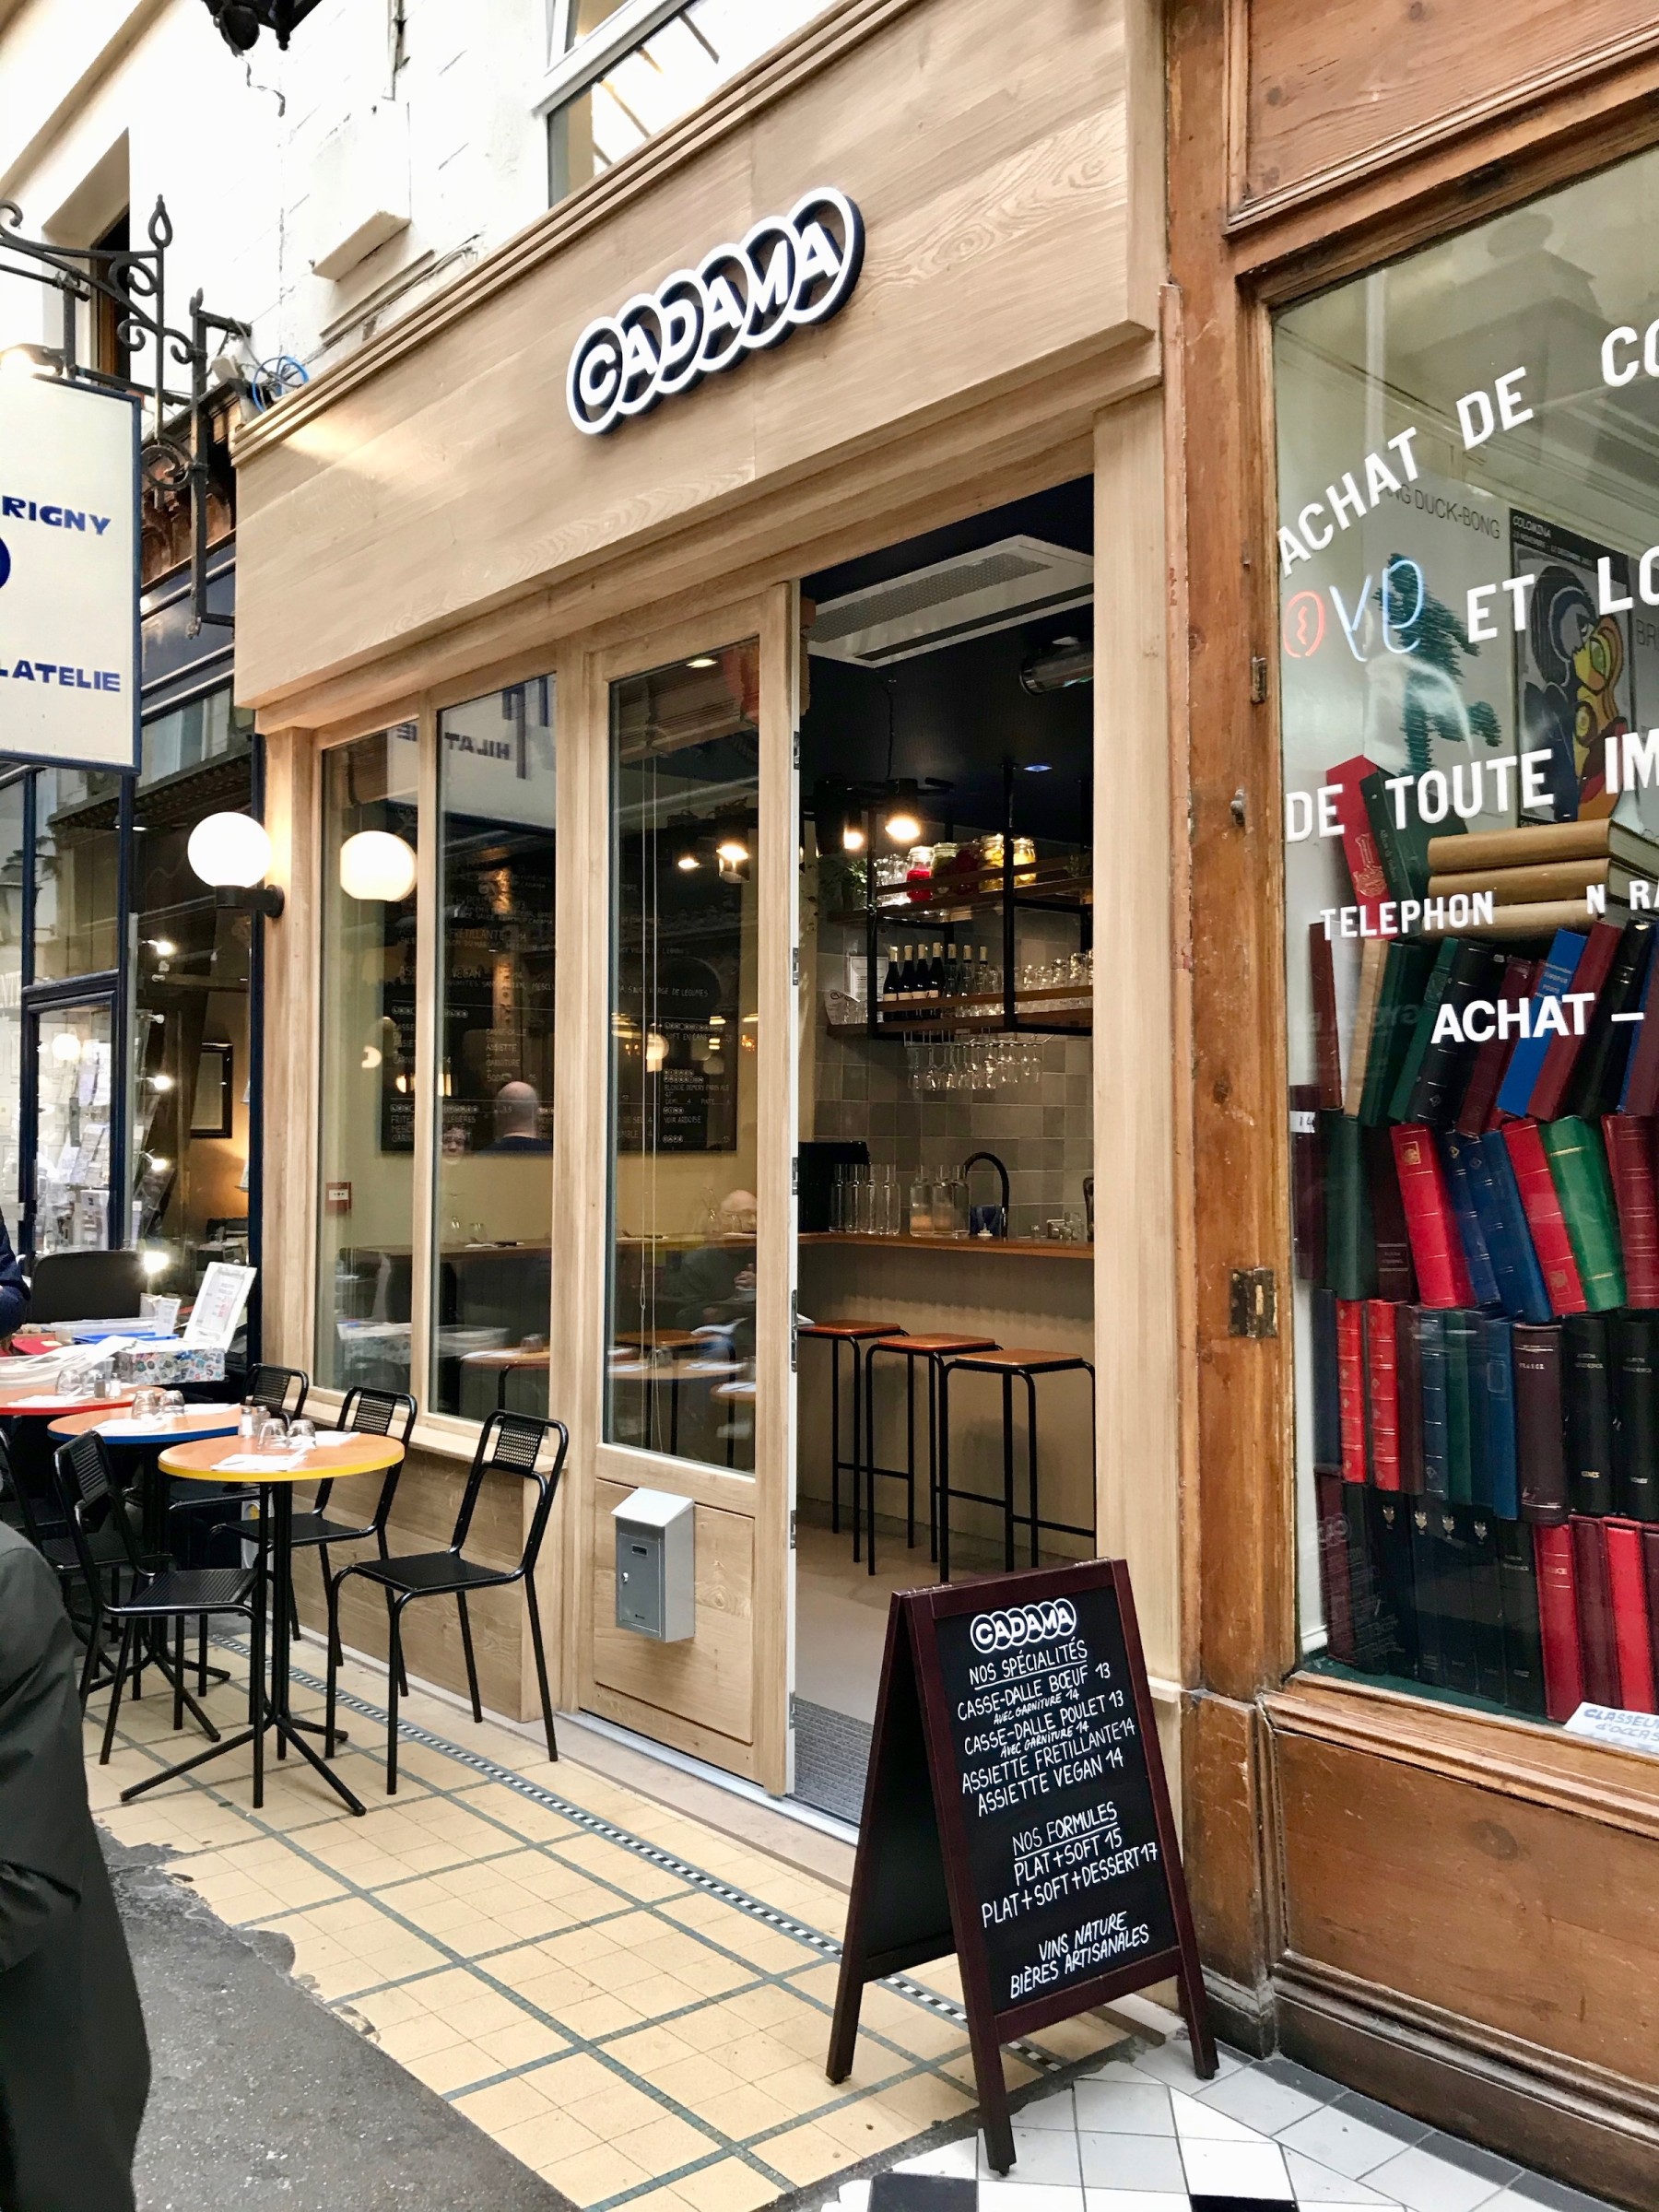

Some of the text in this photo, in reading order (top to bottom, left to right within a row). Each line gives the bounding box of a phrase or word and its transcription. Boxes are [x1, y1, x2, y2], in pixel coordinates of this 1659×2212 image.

[569, 194, 852, 429] CADAMA
[1277, 427, 1418, 578] ACHAT
[1456, 366, 1534, 451] DE
[2, 495, 112, 536] RIGNY
[1415, 488, 1500, 539] DUCK-BONG
[1466, 573, 1535, 643] ET
[1635, 618, 1659, 652] BR
[1285, 783, 1345, 843] DE
[1384, 747, 1553, 830] TOUTE
[1320, 878, 1659, 941] TELEPHON N R
[1430, 993, 1594, 1044] ACHAT
[971, 1601, 1076, 1651] CADAMA
[969, 1636, 1088, 1686] NOS SPÉCIALITÉS
[958, 1679, 1042, 1721] CASSE-DALLE
[1095, 1662, 1111, 1679] 13
[993, 1710, 1015, 1725] AVEC
[1065, 1688, 1079, 1701] 14
[964, 1689, 1124, 1756] CASSE-DALLE POULET 13
[1000, 1742, 1022, 1759] AVEC
[1076, 1720, 1089, 1735] 14
[962, 1717, 1135, 1794] ASSIETTE FRETILLANTE 14
[978, 1747, 1124, 1818] ASSIETTE VEGAN 14
[1013, 1801, 1118, 1856] NOS FORMULES
[1104, 1827, 1123, 1850] 15
[1140, 1841, 1158, 1863] 17
[1010, 1924, 1150, 2000] BIÈRES ARTISANALES
[1039, 1911, 1127, 1962] VINS NATURE
